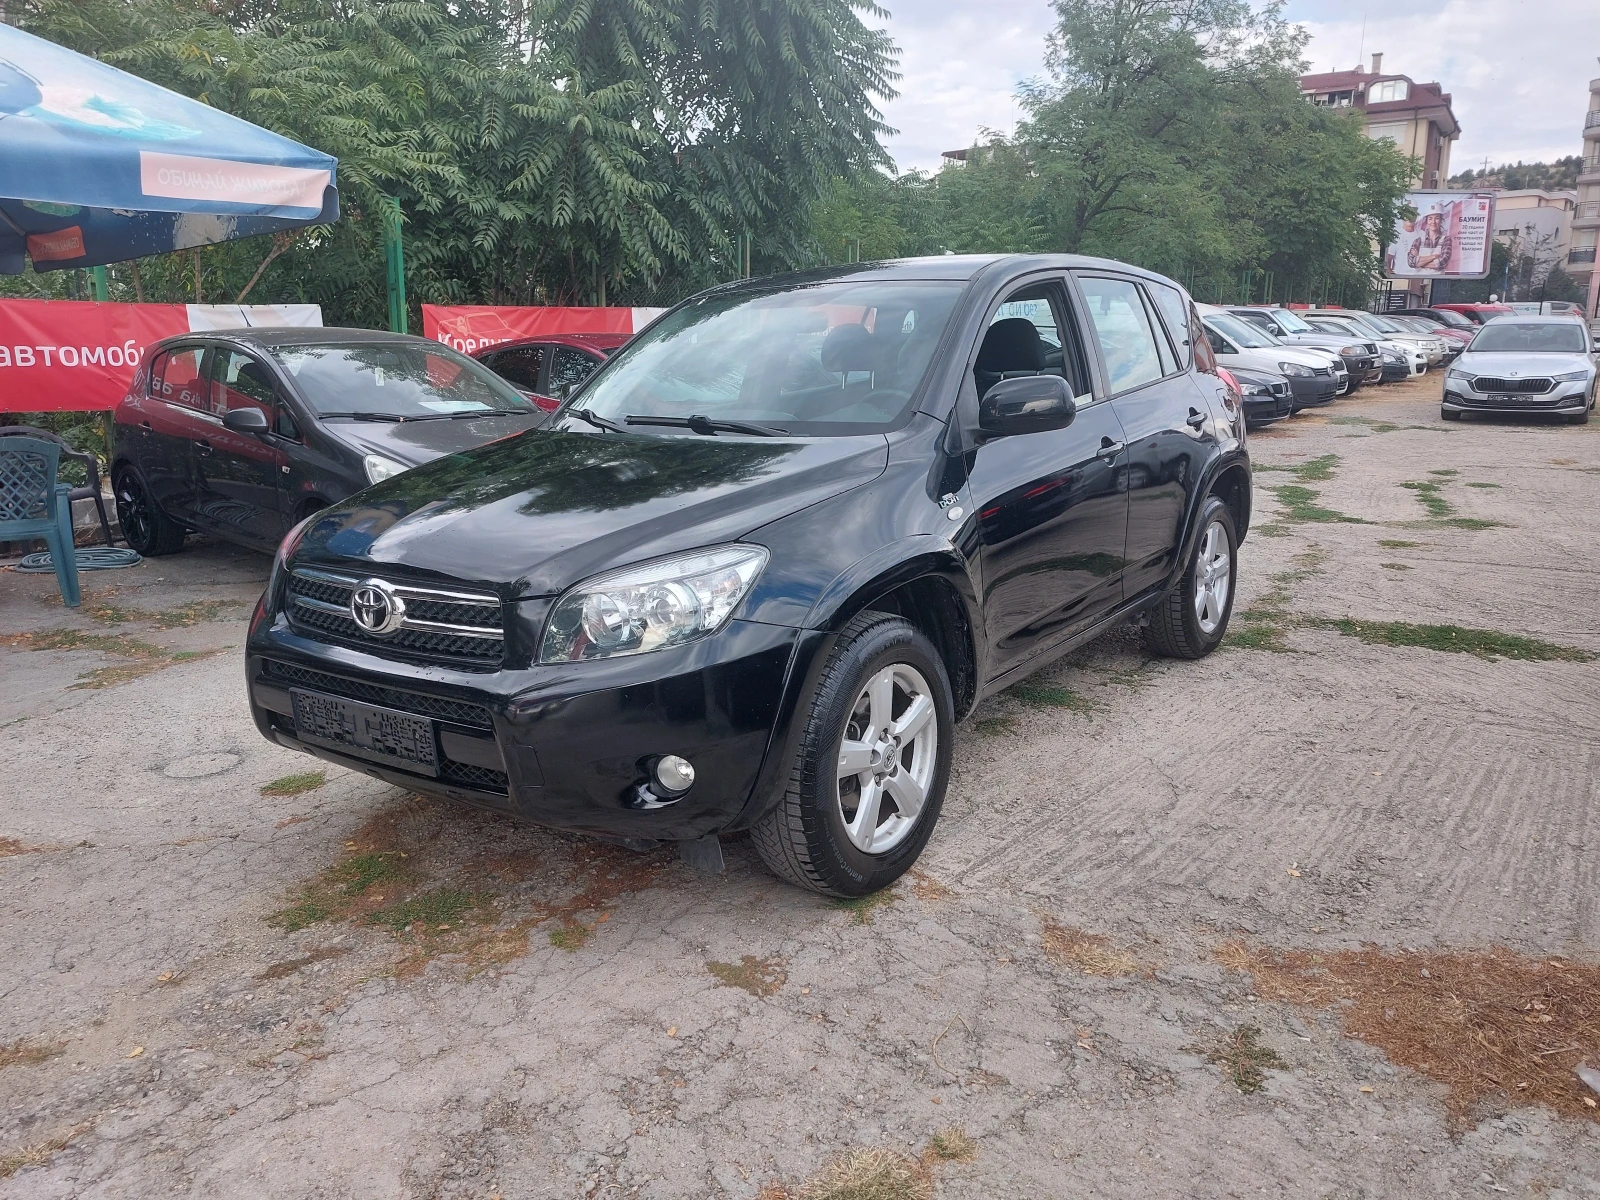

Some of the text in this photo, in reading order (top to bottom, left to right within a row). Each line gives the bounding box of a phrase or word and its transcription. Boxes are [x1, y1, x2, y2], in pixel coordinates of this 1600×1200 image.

[157, 168, 229, 191] ОБИЧАЙ
[0, 339, 145, 367] автомоб
[438, 333, 513, 353] Кре
